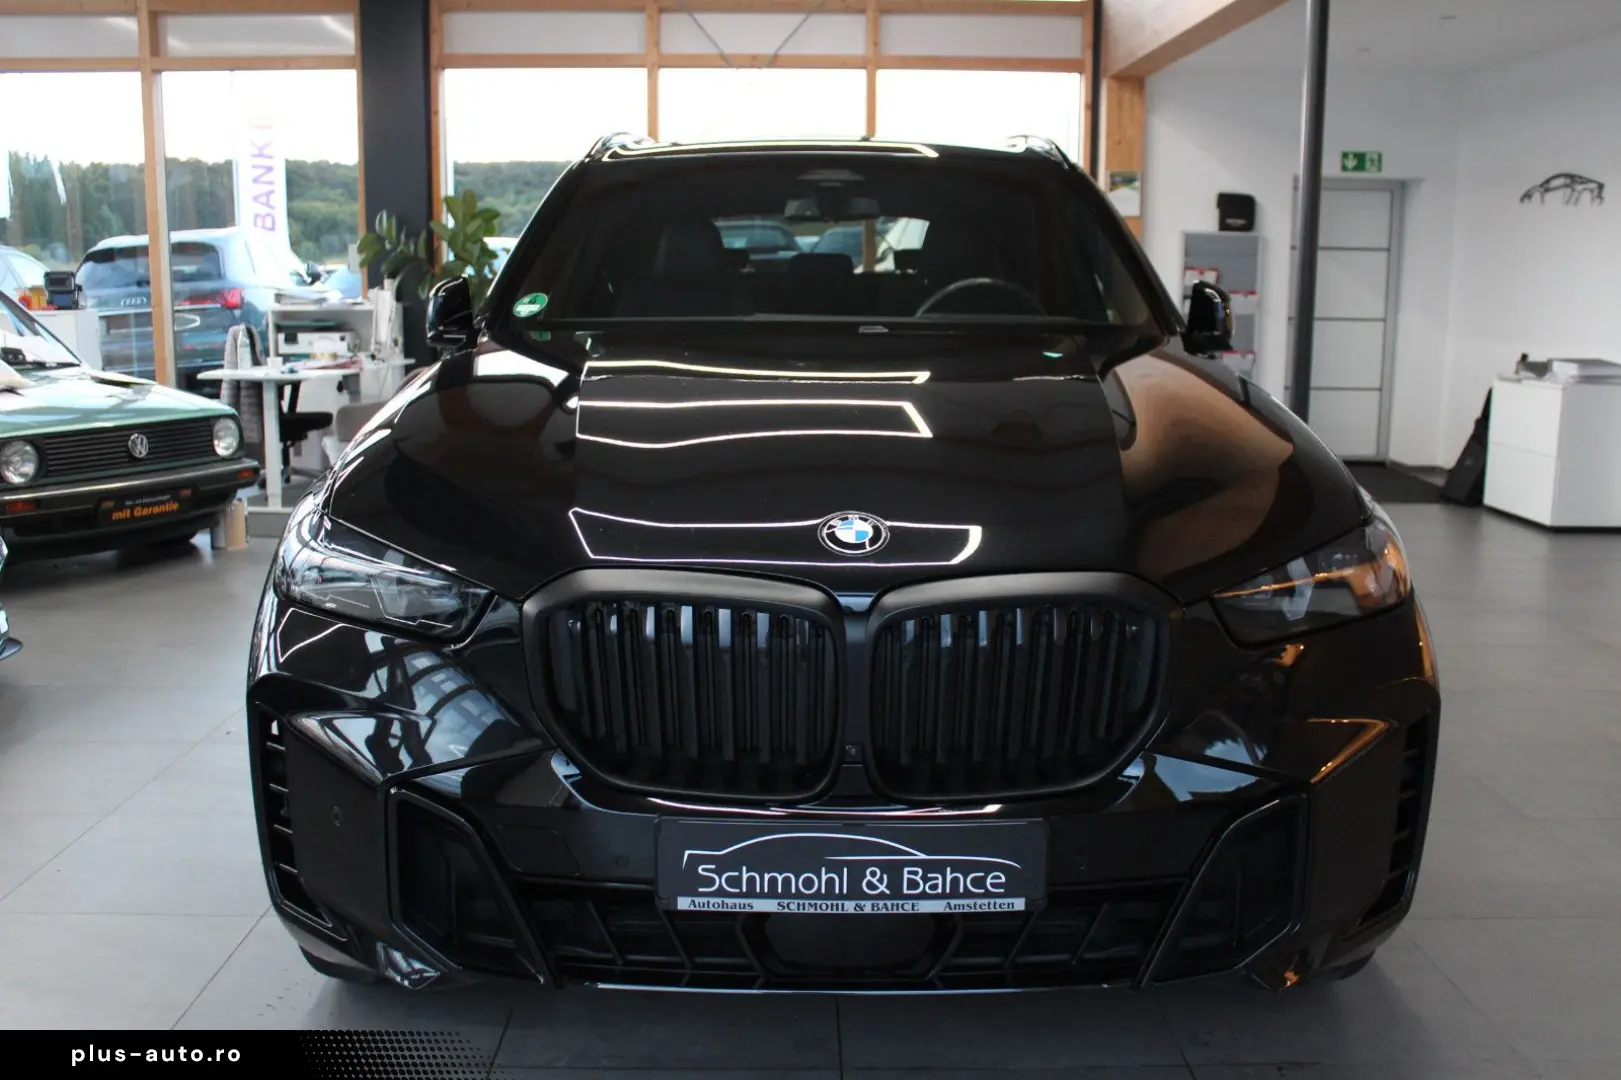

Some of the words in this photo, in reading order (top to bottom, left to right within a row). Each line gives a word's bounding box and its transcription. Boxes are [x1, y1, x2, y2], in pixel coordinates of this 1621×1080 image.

[112, 508, 132, 520] mit
[133, 500, 180, 518] Garantie
[697, 864, 849, 895] Schmohl
[861, 866, 891, 895] &
[902, 866, 1006, 894] Bahce
[688, 899, 754, 911] Autohaus
[776, 901, 849, 912] SCHMOHL
[853, 902, 866, 912] &
[871, 901, 920, 912] BAHCE
[943, 900, 1015, 911] Amstetten
